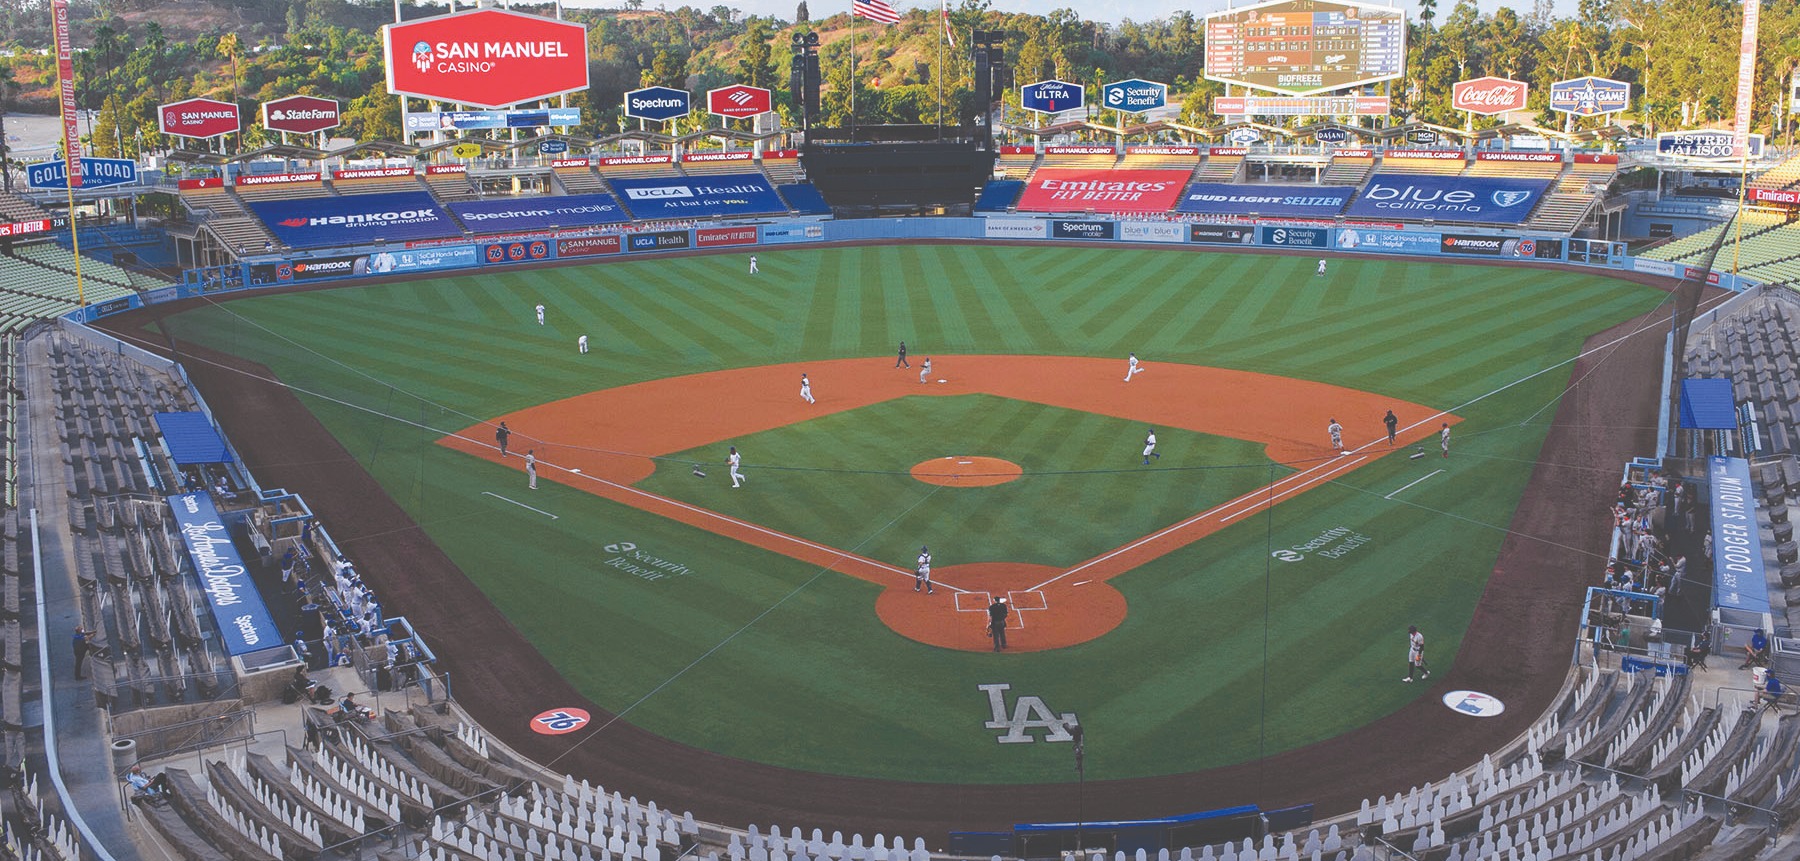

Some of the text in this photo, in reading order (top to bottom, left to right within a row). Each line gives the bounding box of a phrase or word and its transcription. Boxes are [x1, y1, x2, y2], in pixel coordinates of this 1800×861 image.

[56, 8, 71, 60] Emirates
[436, 42, 568, 59] SAN MANUEL
[1034, 91, 1069, 99] ULTRA
[1126, 88, 1160, 97] Security
[1597, 91, 1624, 101] GAME
[632, 98, 682, 110] Spectrum
[1127, 97, 1155, 105] Benefit
[181, 110, 236, 120] SAN MANUEL
[62, 79, 82, 178] Emirates FLY BETTER
[1319, 132, 1344, 140] DASANI
[1665, 145, 1733, 156] JALISCO
[34, 162, 131, 184] GOLDN ROAD
[291, 174, 316, 182] CASINO
[358, 170, 385, 178] MANUEL
[385, 169, 410, 177] CASINO
[636, 184, 765, 198] UCLA Health
[1041, 179, 1166, 192] Emirates
[1051, 191, 1143, 201] FLY BETTER
[1365, 184, 1476, 203] blue
[1756, 189, 1795, 203] Emirates
[664, 201, 679, 209] At
[1190, 194, 1343, 206] BUD LIGHT SELTZER
[462, 205, 612, 221] Spectrum mobile
[1375, 201, 1481, 213] california
[12, 222, 23, 234] FLY
[23, 220, 44, 232] BETTER
[53, 218, 65, 227] 7:14
[345, 215, 439, 229] driving emotion
[1063, 223, 1101, 232] Spectrum
[1124, 226, 1140, 234] blue
[1154, 227, 1171, 235] blue
[1288, 229, 1316, 239] Security
[586, 238, 618, 246] MANUEL
[636, 237, 654, 246] UCLA
[658, 235, 684, 245] Health
[699, 233, 727, 242] Emirates
[1289, 237, 1313, 245] Benefit
[490, 245, 544, 258] 76 76 76
[1522, 243, 1533, 252] 76
[279, 267, 290, 276] 76
[182, 495, 199, 514] Spectrum
[1719, 477, 1747, 520] STADIUM
[1292, 525, 1355, 553] Security
[189, 533, 231, 567] Angeles
[1318, 532, 1371, 559] Benefit
[1722, 523, 1753, 573] DODGER
[604, 556, 664, 581] Benefit
[627, 549, 695, 576] Security
[205, 565, 245, 606] Dodgers
[234, 614, 260, 645] Spectrum
[977, 683, 1080, 743] LA
[536, 710, 587, 731] 76
